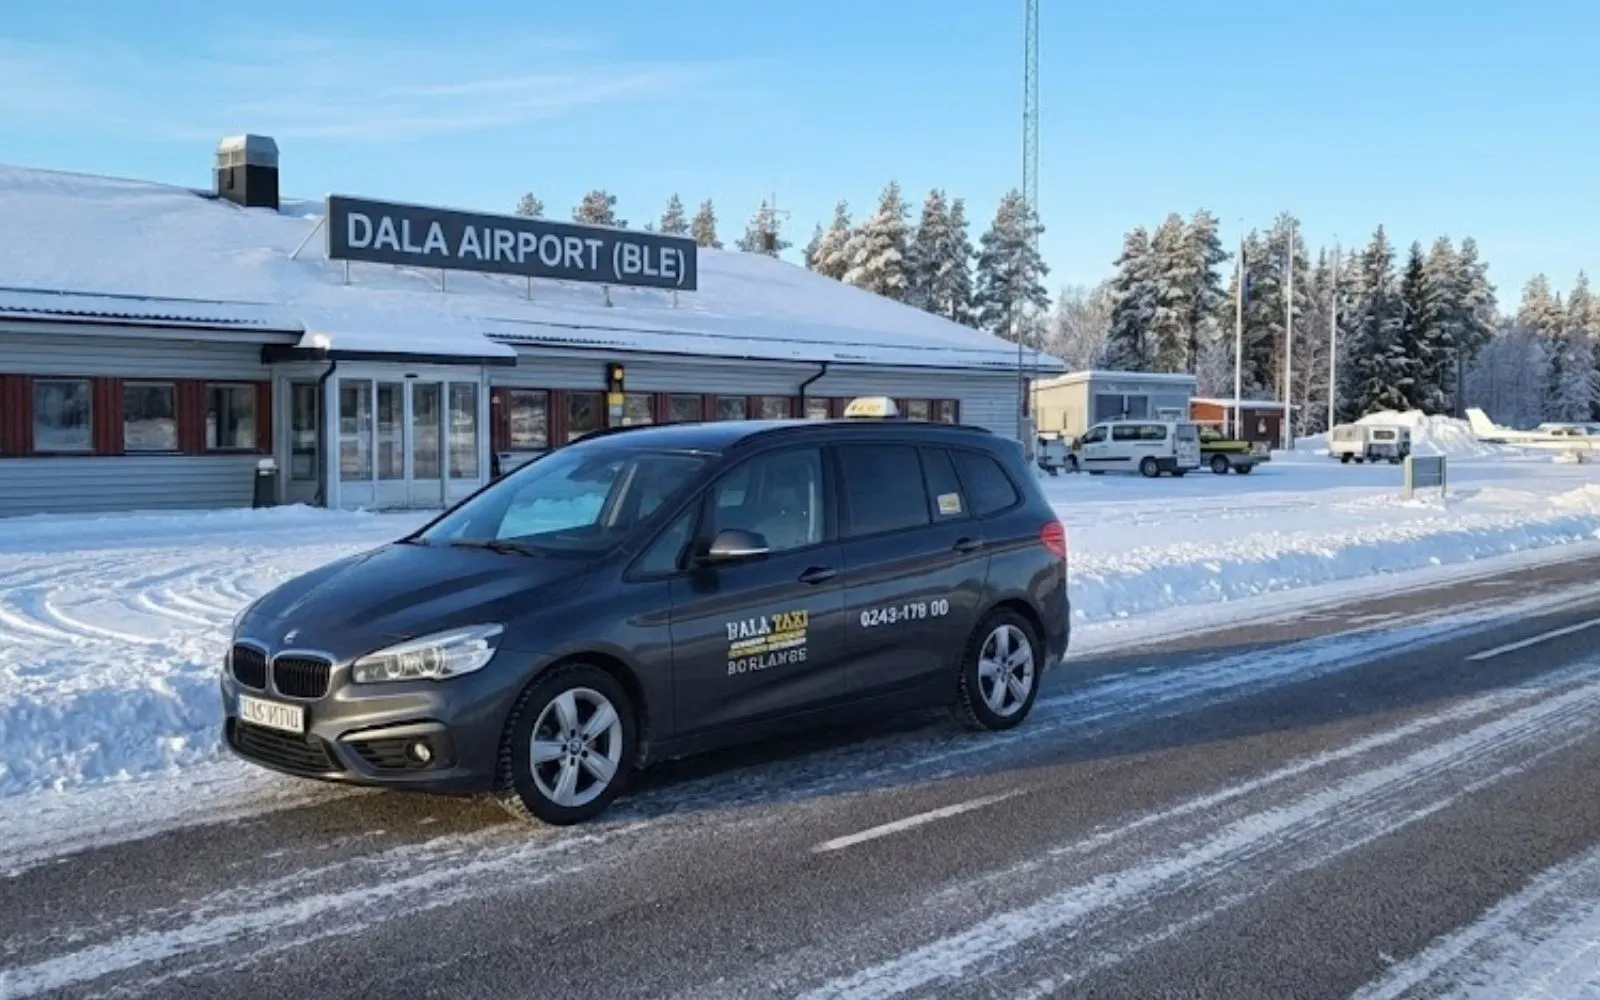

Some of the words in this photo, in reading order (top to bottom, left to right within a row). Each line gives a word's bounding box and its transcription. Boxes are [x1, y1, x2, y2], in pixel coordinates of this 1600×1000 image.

[347, 212, 449, 257] DALA
[458, 224, 603, 270] AIRPORT
[612, 240, 686, 286] (BLE)
[931, 598, 949, 617] 00
[773, 609, 808, 632] TAXI
